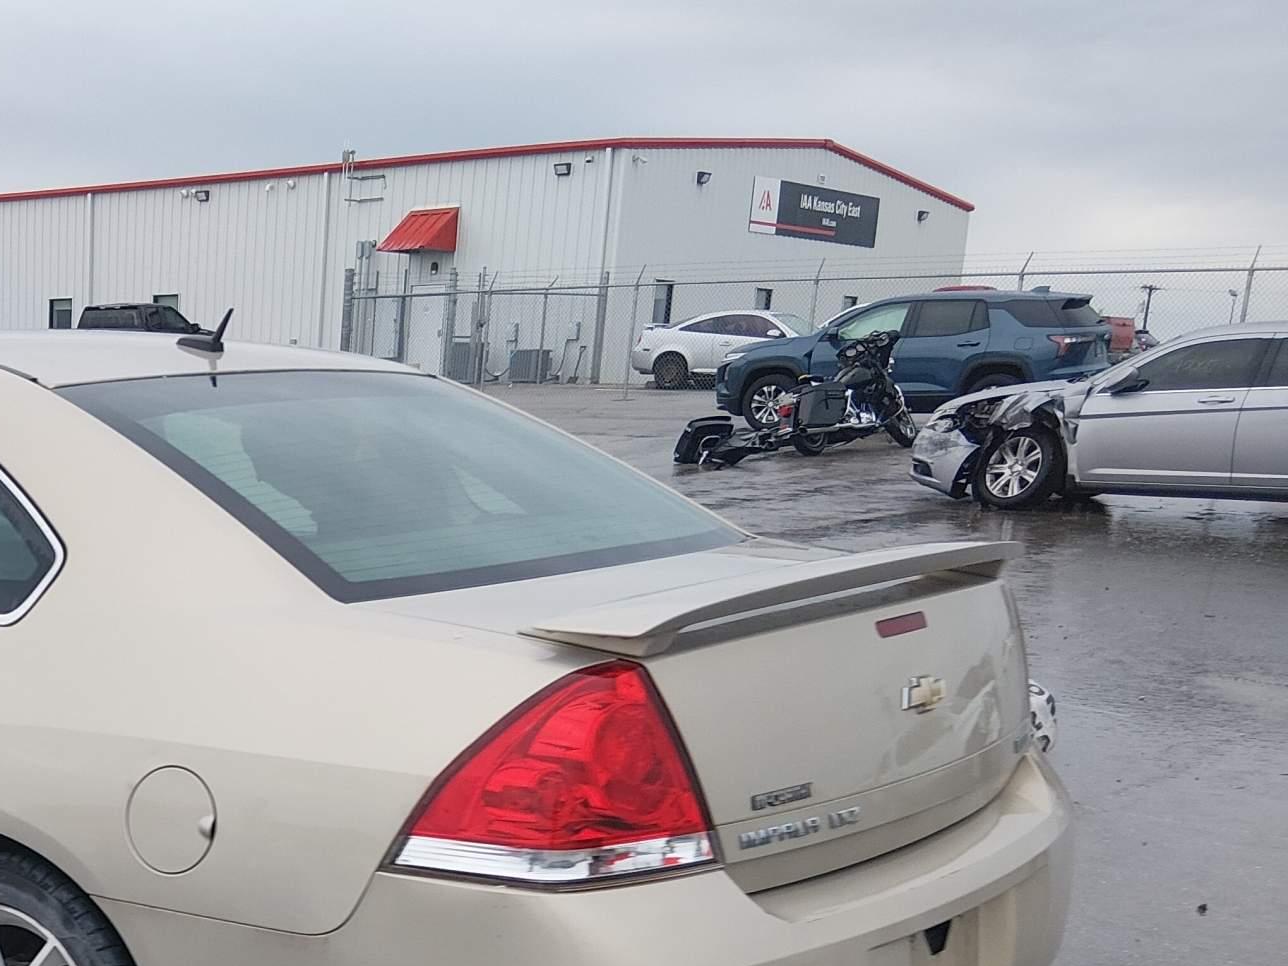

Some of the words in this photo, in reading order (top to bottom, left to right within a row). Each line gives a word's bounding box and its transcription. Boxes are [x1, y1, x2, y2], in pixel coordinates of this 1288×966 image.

[800, 192, 812, 210] IAA
[813, 195, 835, 213] Kansas
[835, 199, 848, 219] City
[848, 201, 861, 218] East
